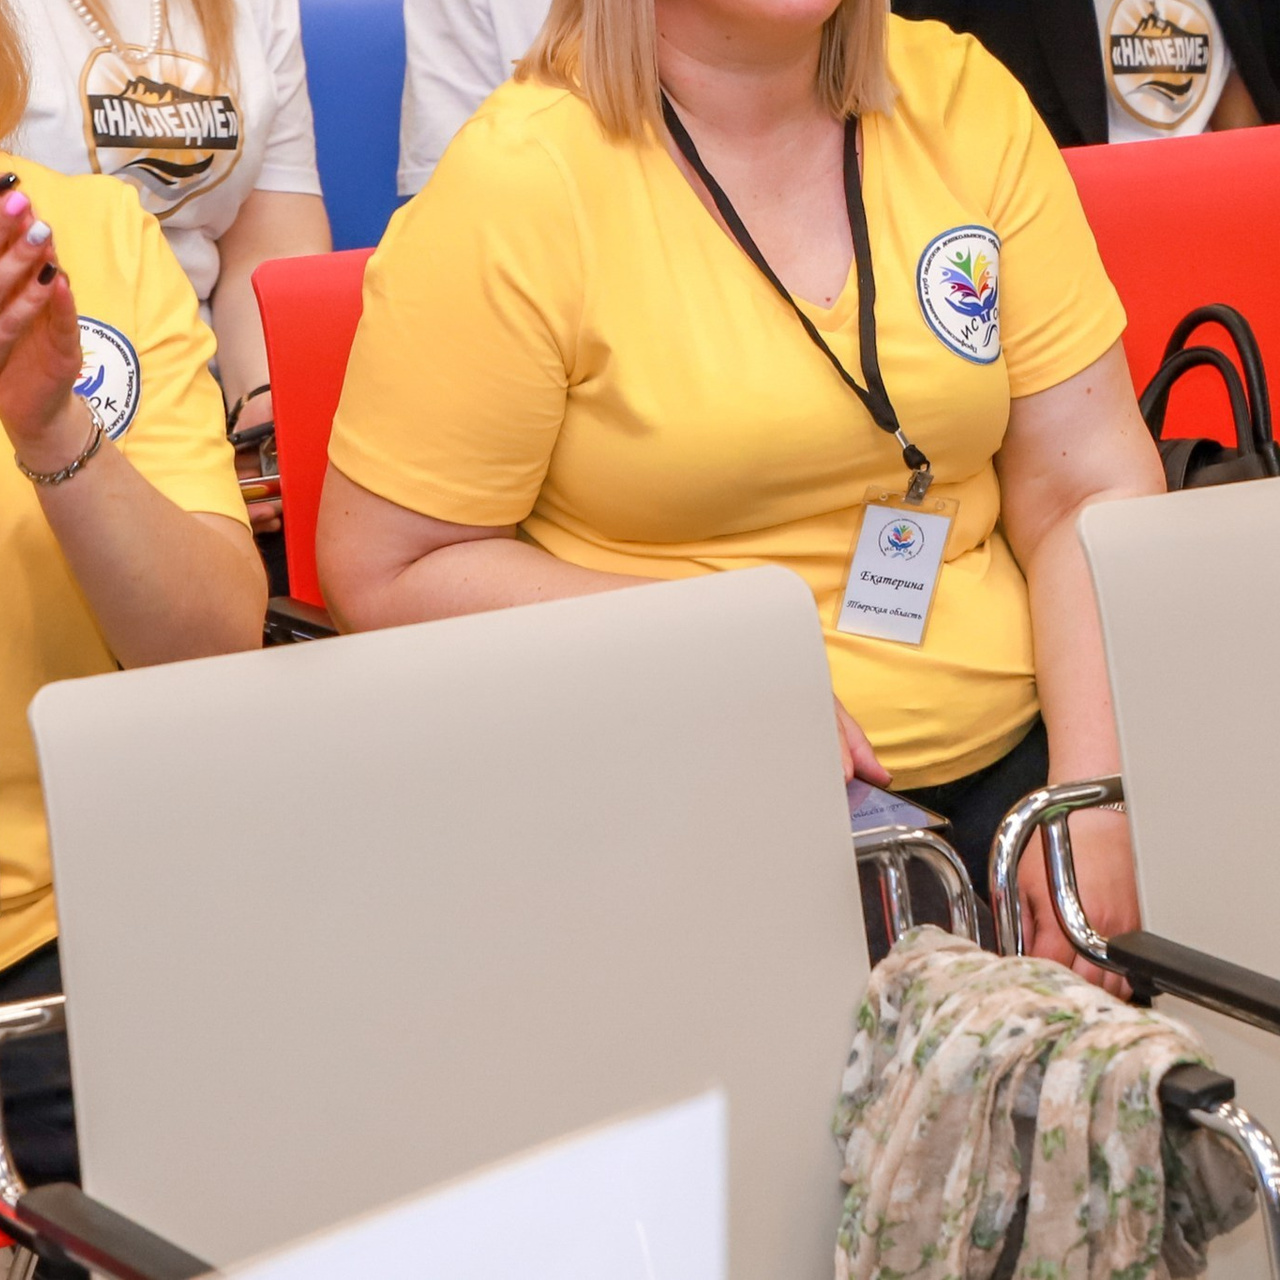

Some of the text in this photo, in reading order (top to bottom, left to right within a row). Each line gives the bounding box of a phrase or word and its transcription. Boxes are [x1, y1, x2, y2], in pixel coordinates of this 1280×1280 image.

[1112, 37, 1208, 71] «НАСЛЕДИЕ»
[94, 98, 238, 146] «НАСЛЕДИЕ»
[961, 307, 999, 341] ИСТО
[860, 570, 924, 591] Екатерина
[846, 600, 923, 620] Тверская область
